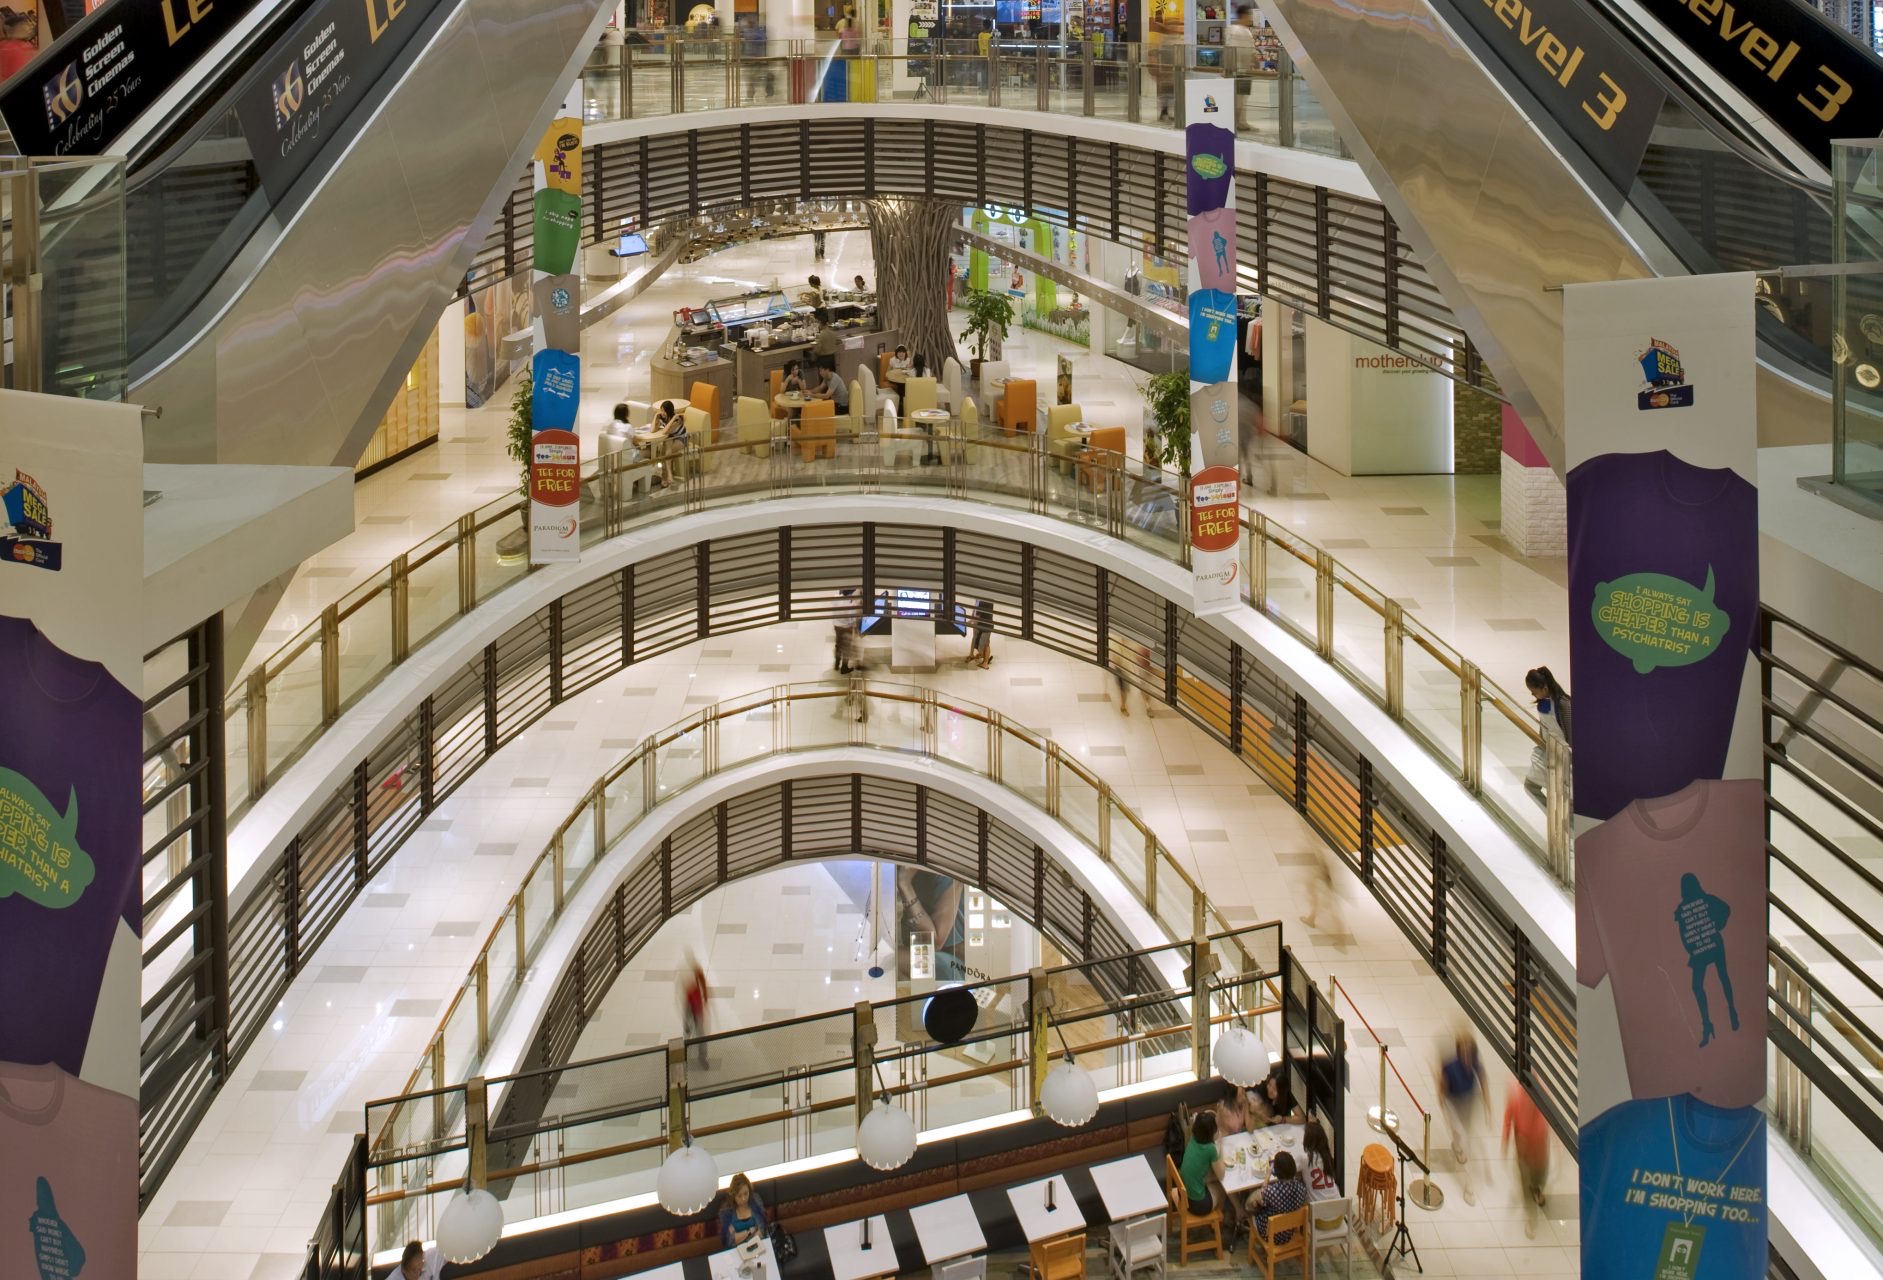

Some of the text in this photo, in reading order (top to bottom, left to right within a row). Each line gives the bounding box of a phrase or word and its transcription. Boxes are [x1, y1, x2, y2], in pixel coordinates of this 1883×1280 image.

[83, 24, 123, 63] Golden
[85, 41, 125, 80] Screen
[304, 21, 336, 61] Golden
[305, 38, 337, 79] Screen
[88, 50, 135, 98] Cinemas
[307, 48, 344, 96] Cinemas
[1581, 72, 1627, 131] 3
[1797, 64, 1853, 122] 3
[55, 75, 142, 156] Celebrating 25 Years
[281, 106, 320, 157] Celebrating
[1657, 352, 1679, 368] MEGA
[1657, 362, 1680, 376] SALE
[536, 468, 575, 478] TEE FOR
[23, 488, 46, 516] MEGA
[23, 503, 47, 526] SALE
[1197, 508, 1235, 521] TEE FOR
[534, 524, 568, 532] PARADIGM
[1195, 571, 1230, 582] PARADIGM
[1610, 590, 1711, 629] SHOPPING IS
[1642, 587, 1675, 602] ALWAYS
[1676, 597, 1692, 607] SAY
[1598, 606, 1710, 646] CHEAPER THAN A
[1612, 627, 1692, 655] PSYCHIATRIST
[0, 787, 52, 831] ALWAYS SAY
[0, 801, 49, 852] PPING
[51, 841, 71, 869] IS
[31, 849, 70, 894] THAN A
[1632, 1168, 1639, 1182] I
[1641, 1171, 1683, 1190] DON'T
[1686, 1178, 1726, 1197] WORK
[1625, 1188, 1646, 1205] I'M
[1649, 1192, 1718, 1217] SHOPPING
